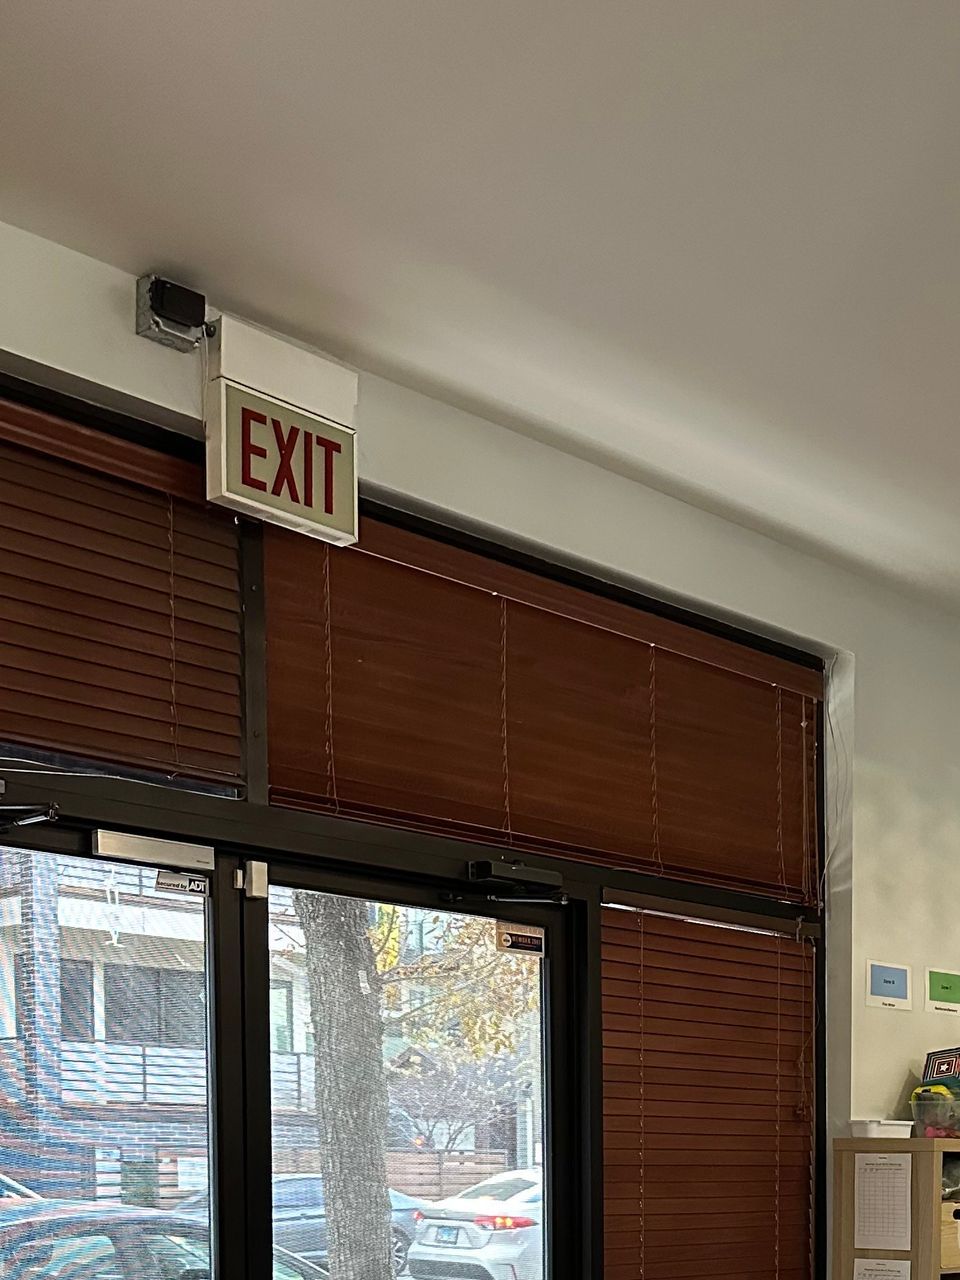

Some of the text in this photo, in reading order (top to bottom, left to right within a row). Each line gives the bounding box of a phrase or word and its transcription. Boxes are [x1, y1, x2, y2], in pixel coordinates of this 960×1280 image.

[241, 406, 342, 515] EXIT
[157, 881, 180, 889] secured
[189, 880, 206, 892] ADT
